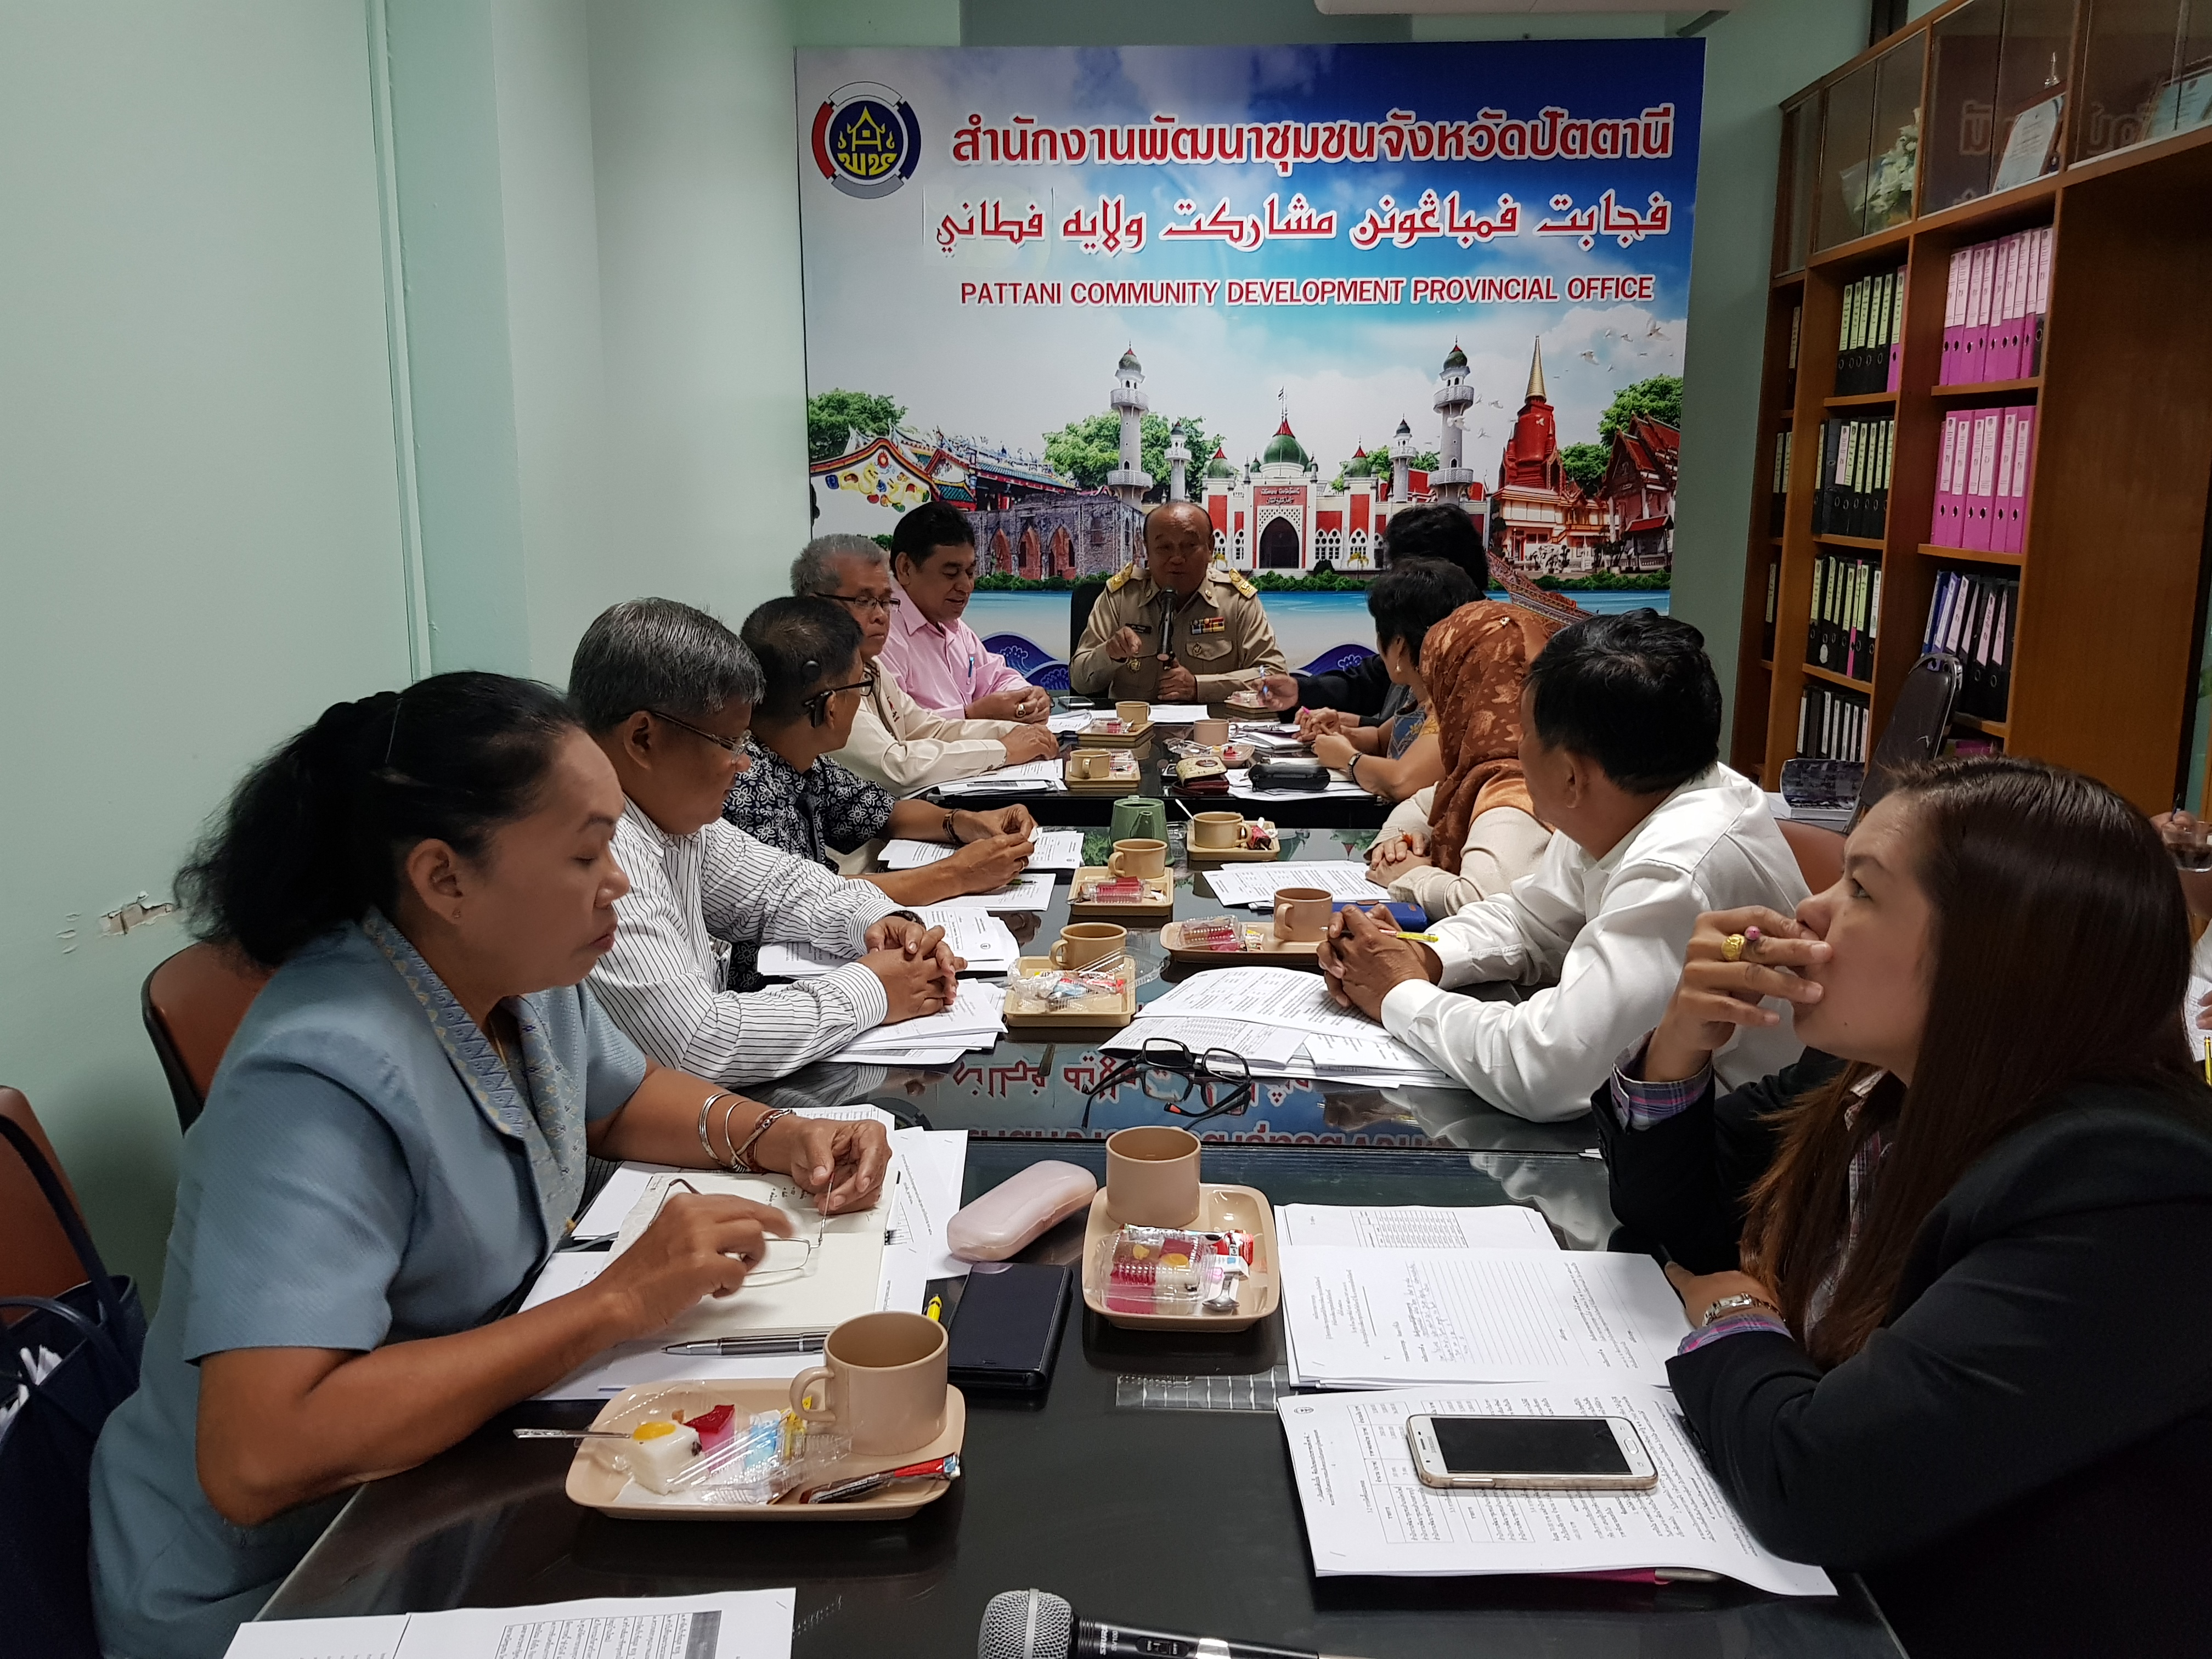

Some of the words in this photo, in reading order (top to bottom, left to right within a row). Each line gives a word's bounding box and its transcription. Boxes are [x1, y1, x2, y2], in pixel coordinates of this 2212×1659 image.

[952, 106, 1672, 173] สำนักงานพัฒนาชุมชนจังหวัดปัตตานี
[1536, 192, 1669, 247] فجابت
[961, 282, 1062, 304] PATTANI
[1070, 281, 1217, 304] COMMUNITY
[1228, 280, 1405, 303] DEVELOPMENT
[1413, 278, 1558, 303] PROVINCIAL
[1567, 276, 1654, 300] OFFICE
[1099, 1624, 1108, 1656] SHURE
